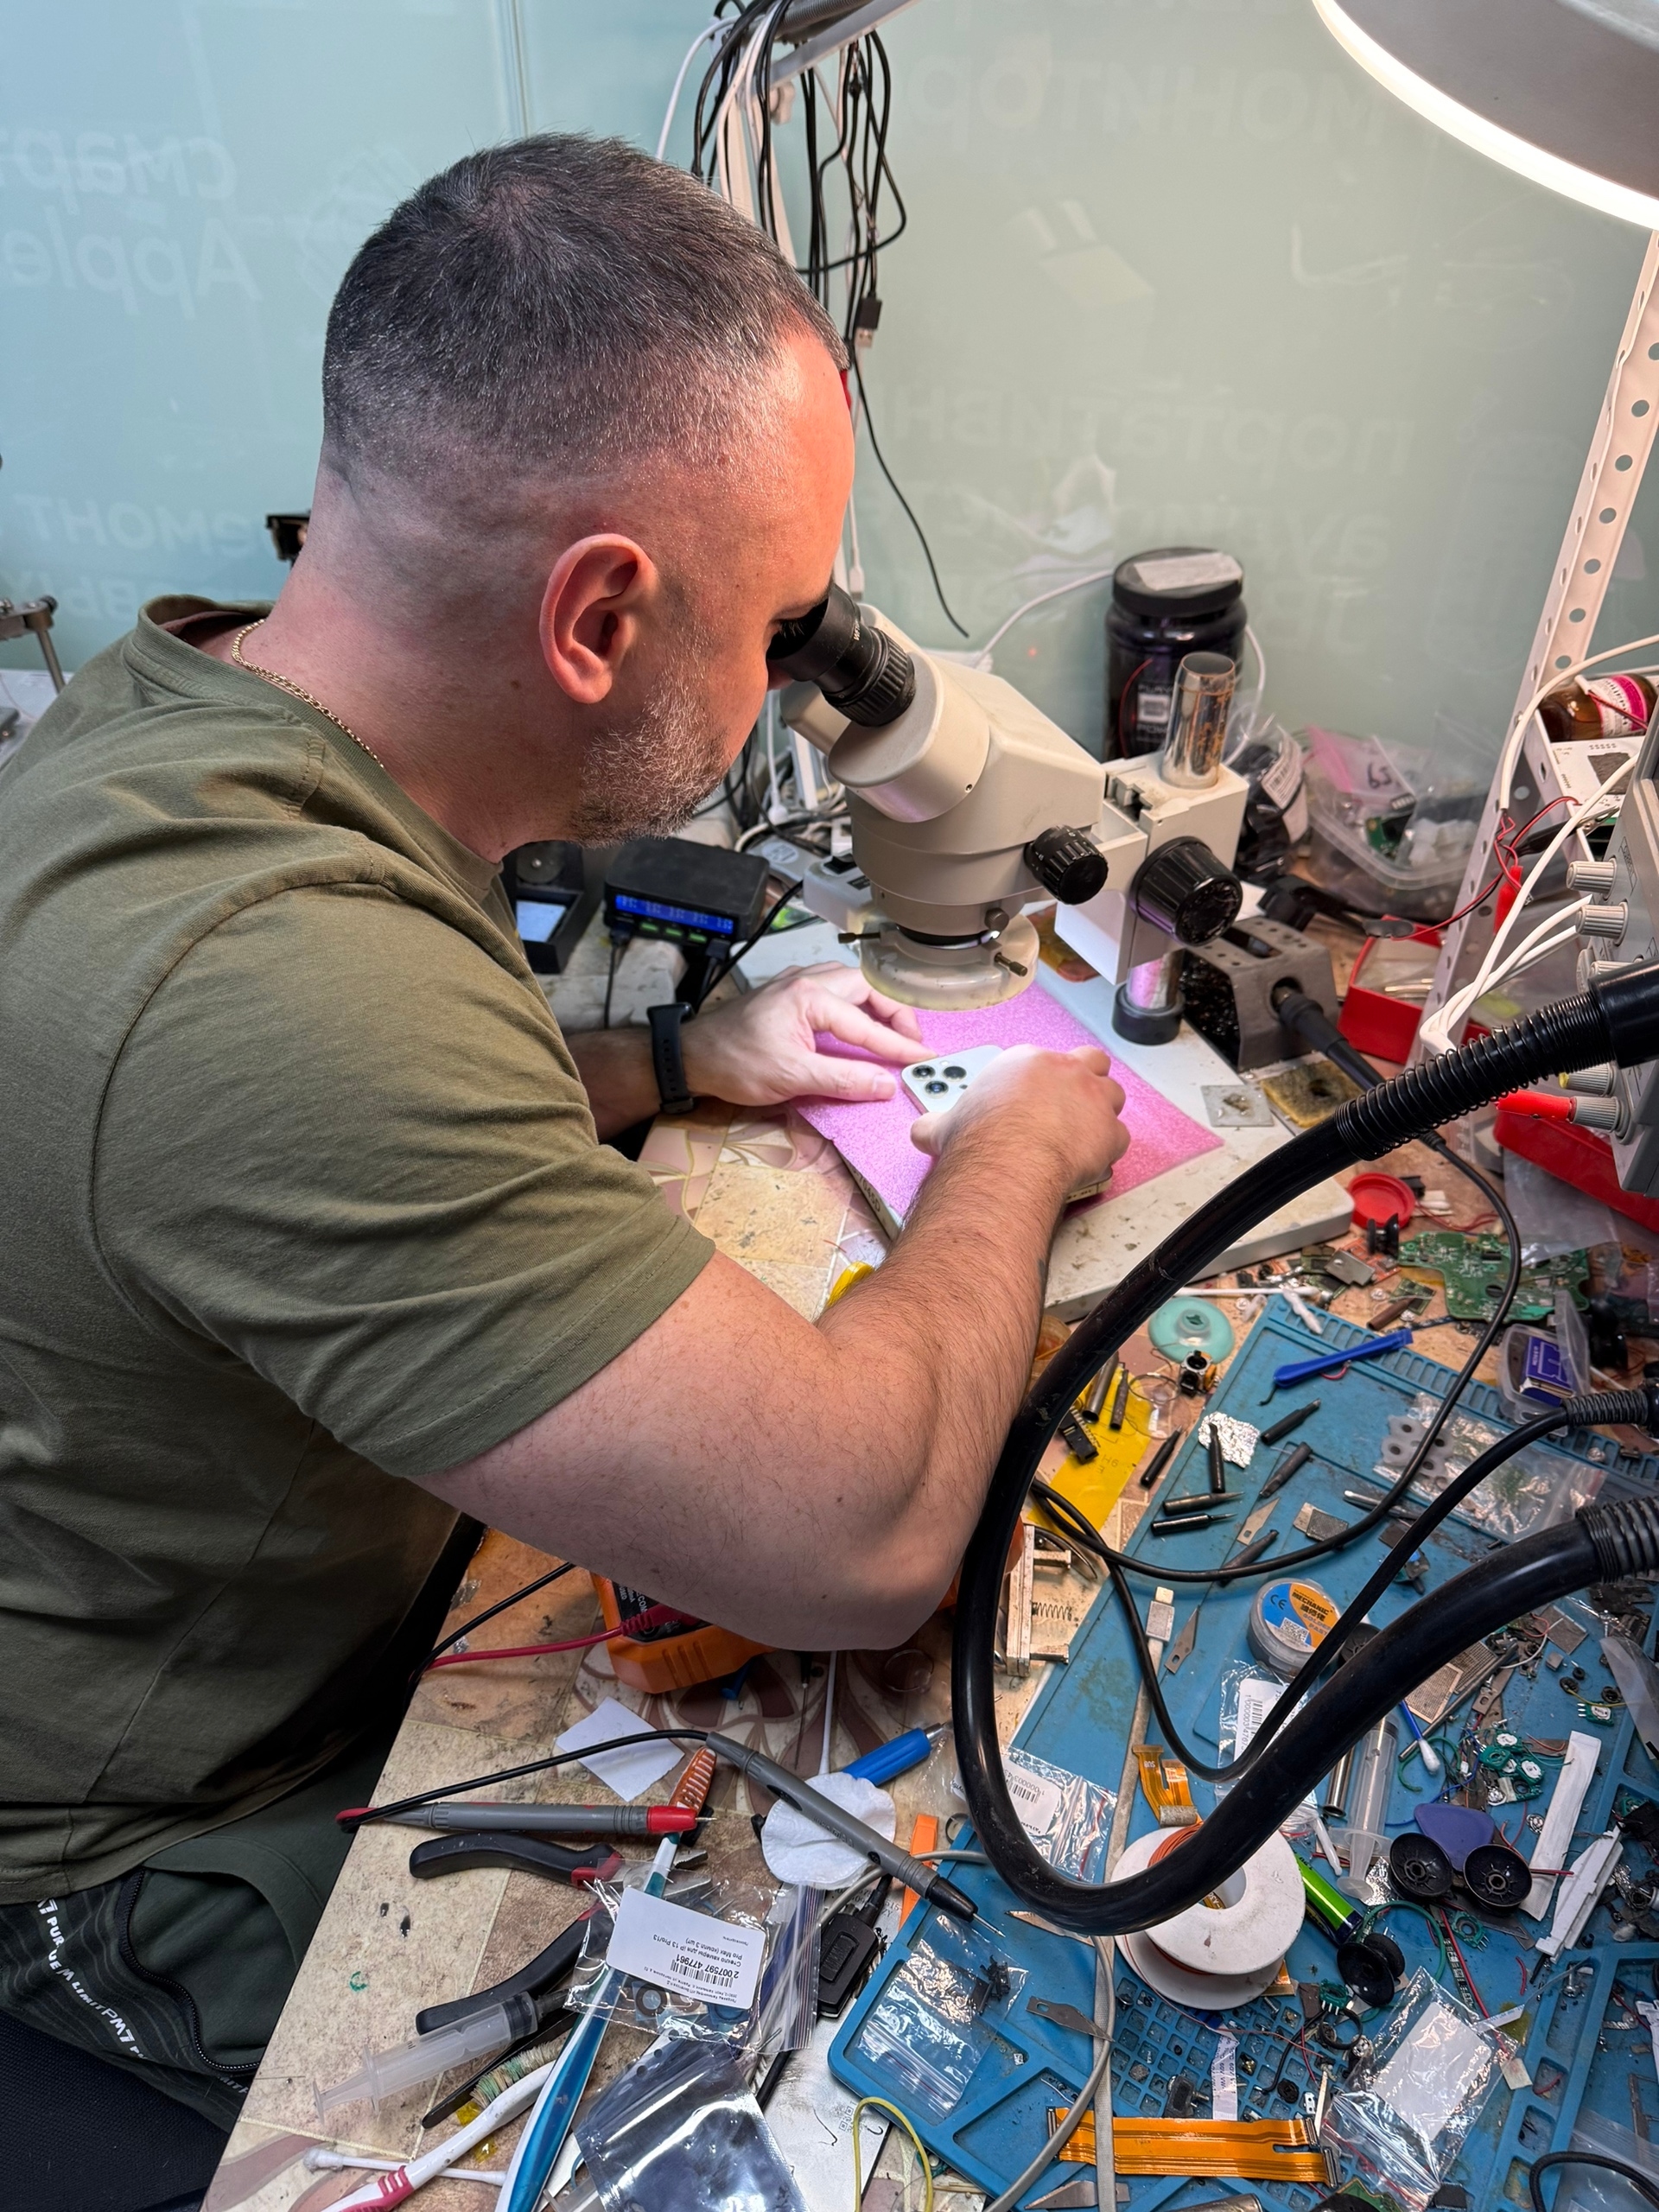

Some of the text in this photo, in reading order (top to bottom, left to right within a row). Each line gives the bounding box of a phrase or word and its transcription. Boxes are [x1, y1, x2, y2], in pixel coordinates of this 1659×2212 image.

[1292, 1592, 1329, 1616] MECHANIC
[1308, 1623, 1328, 1636] PAST
[653, 1934, 671, 1947] Pro/13
[672, 1941, 679, 1949] 13
[698, 1950, 720, 1961] камеры
[721, 1957, 741, 1967] Стекло
[676, 1954, 740, 1979] 2 007597 477961
